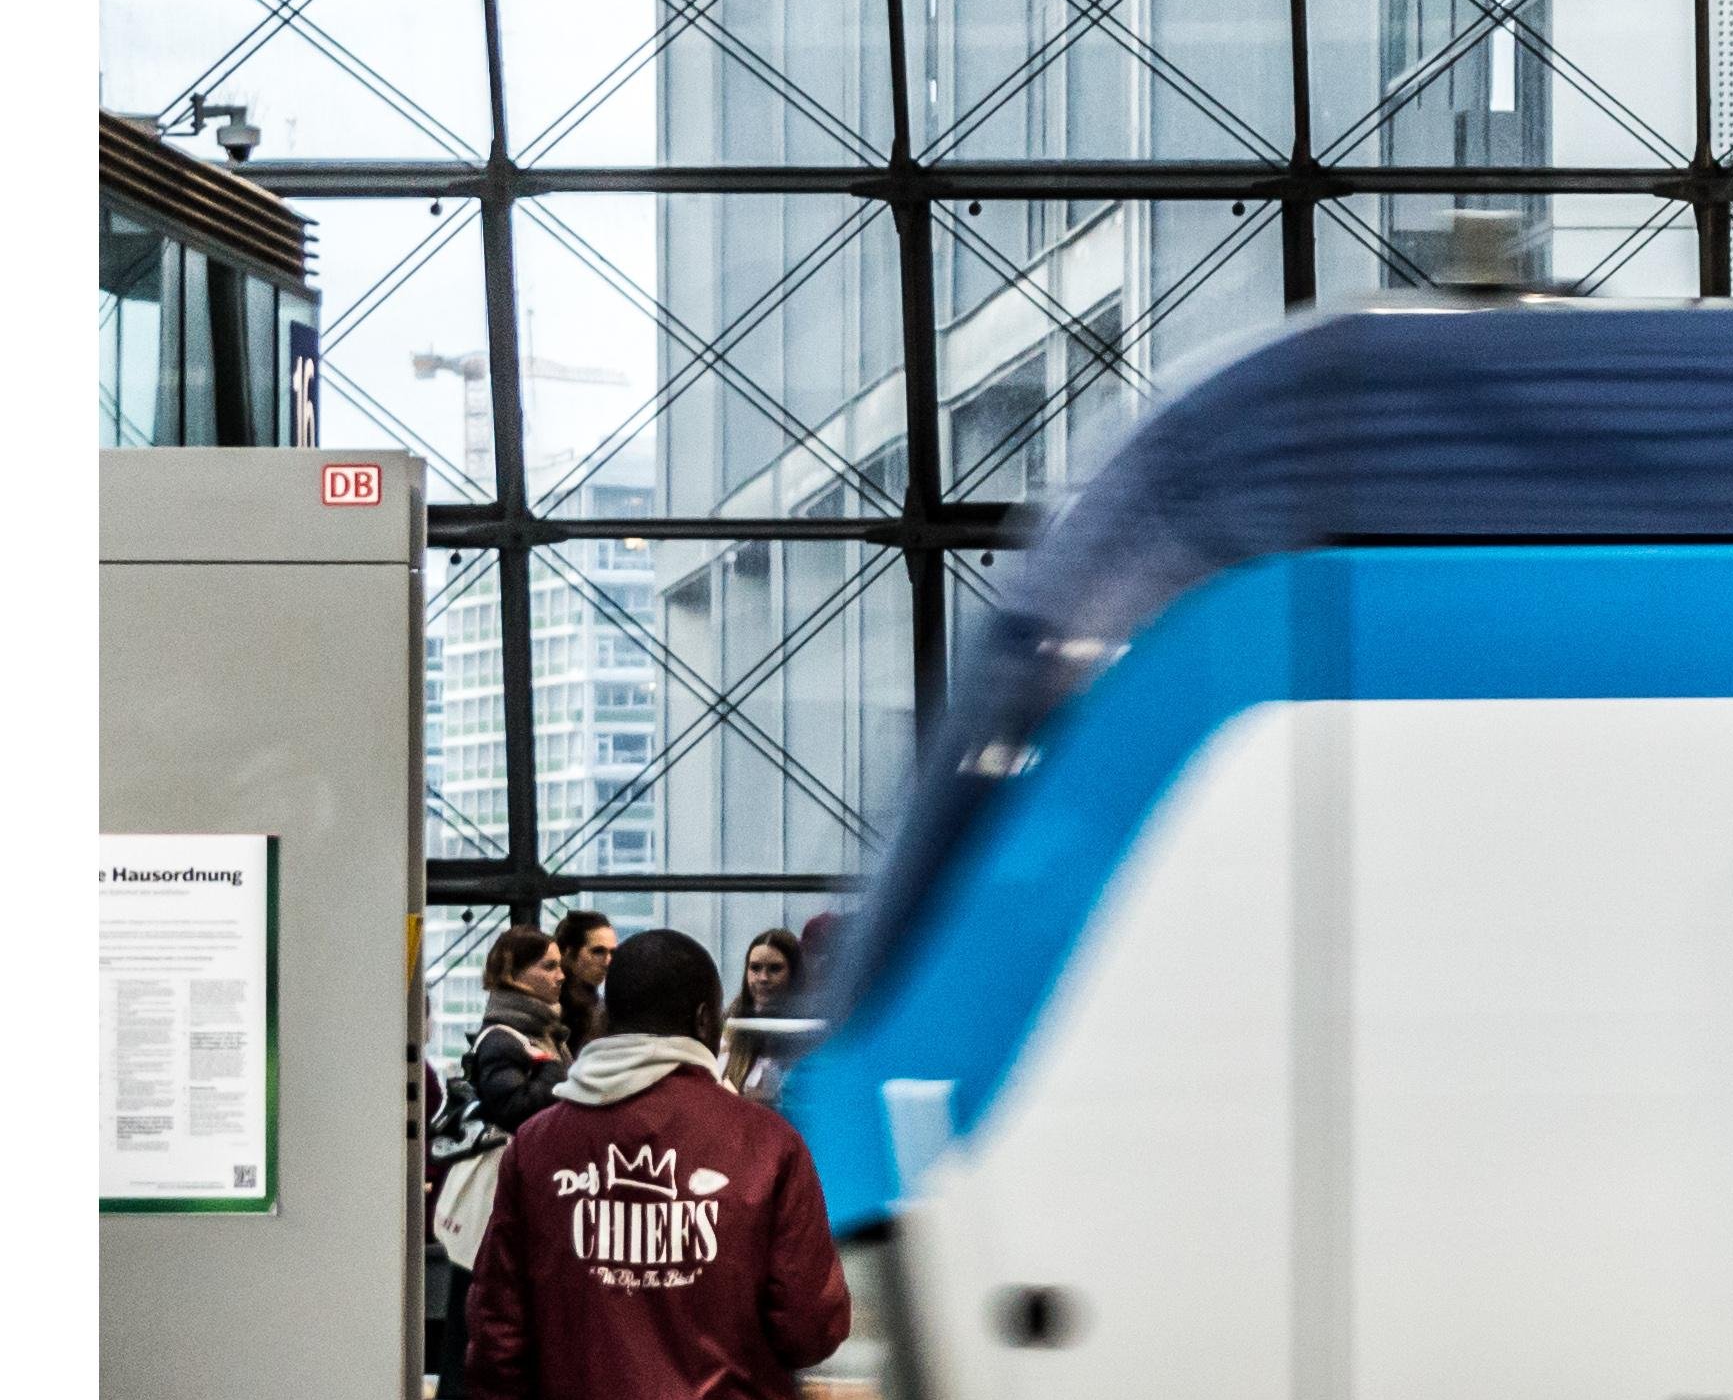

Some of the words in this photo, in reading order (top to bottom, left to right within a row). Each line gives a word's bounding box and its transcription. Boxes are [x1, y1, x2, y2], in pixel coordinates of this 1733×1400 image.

[330, 471, 373, 499] DB
[112, 866, 243, 886] Hausordnung
[573, 1198, 719, 1264] CHIEFS
